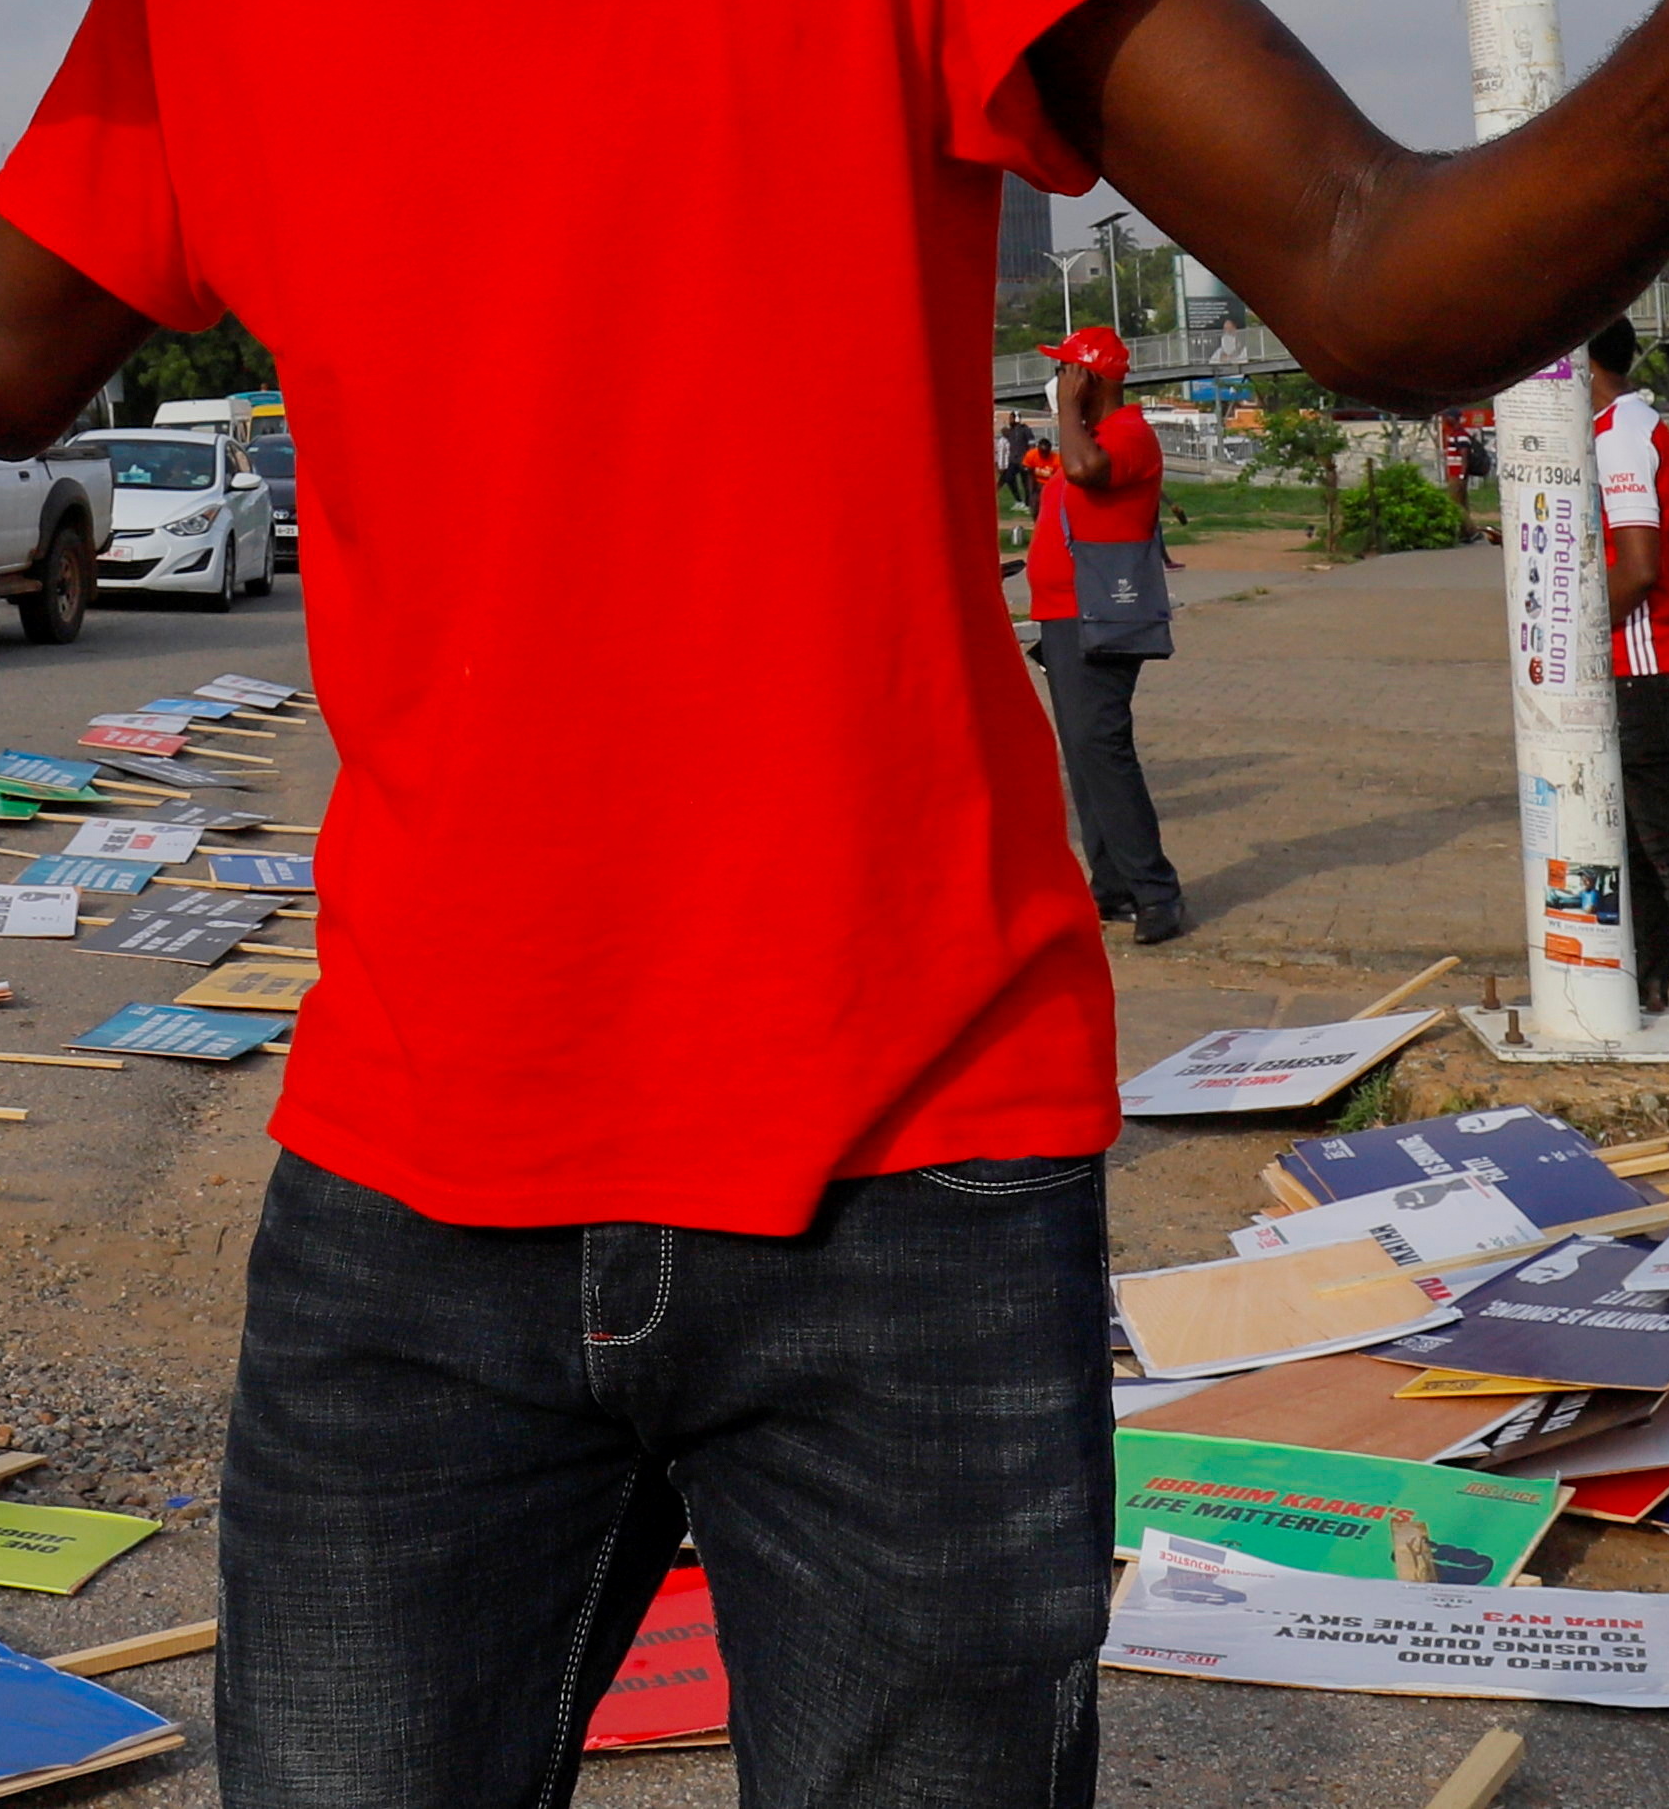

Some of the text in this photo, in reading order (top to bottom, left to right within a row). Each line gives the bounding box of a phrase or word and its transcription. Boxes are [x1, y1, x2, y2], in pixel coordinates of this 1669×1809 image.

[1608, 472, 1634, 483] VISIT
[1144, 1477, 1416, 1522] IBRAHIM KAAKA'S
[1125, 1494, 1370, 1540] LIFE MATTERED!
[0, 1539, 62, 1555] ONE
[1373, 1618, 1645, 1642] TO BATH IN THE
[1563, 1616, 1643, 1628] NIPA
[1273, 1626, 1645, 1657] IS USING OUR MONEY
[1397, 1651, 1646, 1672] AKUFFO ADDO
